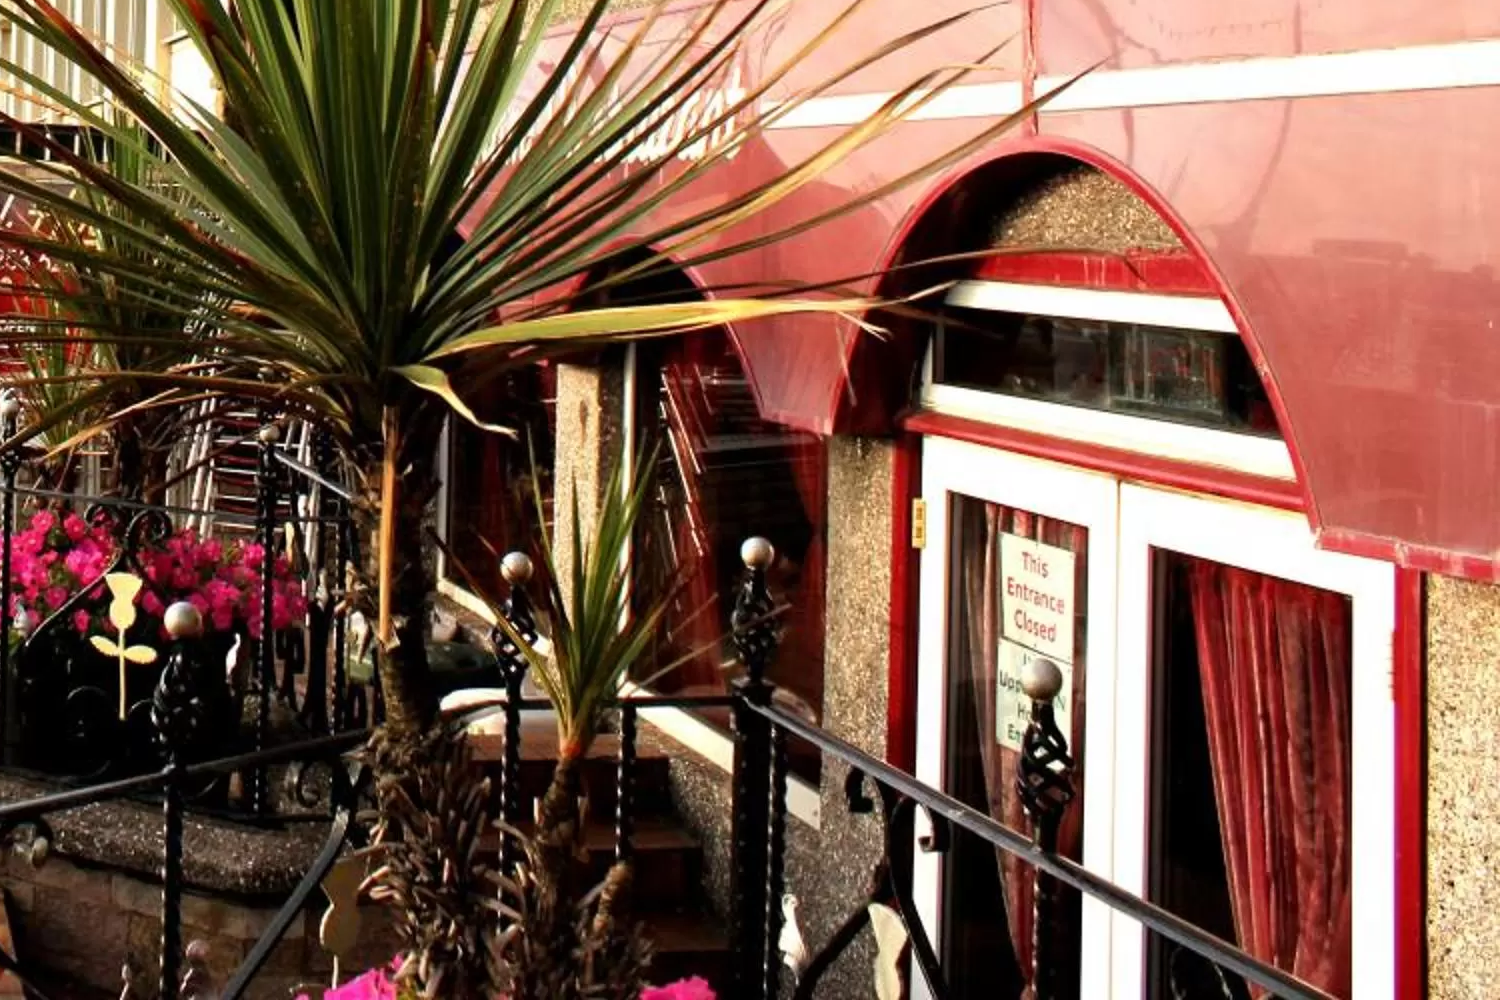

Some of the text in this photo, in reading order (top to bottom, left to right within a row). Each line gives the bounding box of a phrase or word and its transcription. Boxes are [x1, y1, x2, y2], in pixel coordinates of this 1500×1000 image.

[1022, 551, 1049, 579] This
[1006, 576, 1065, 615] Entrance
[1013, 610, 1057, 643] Closed
